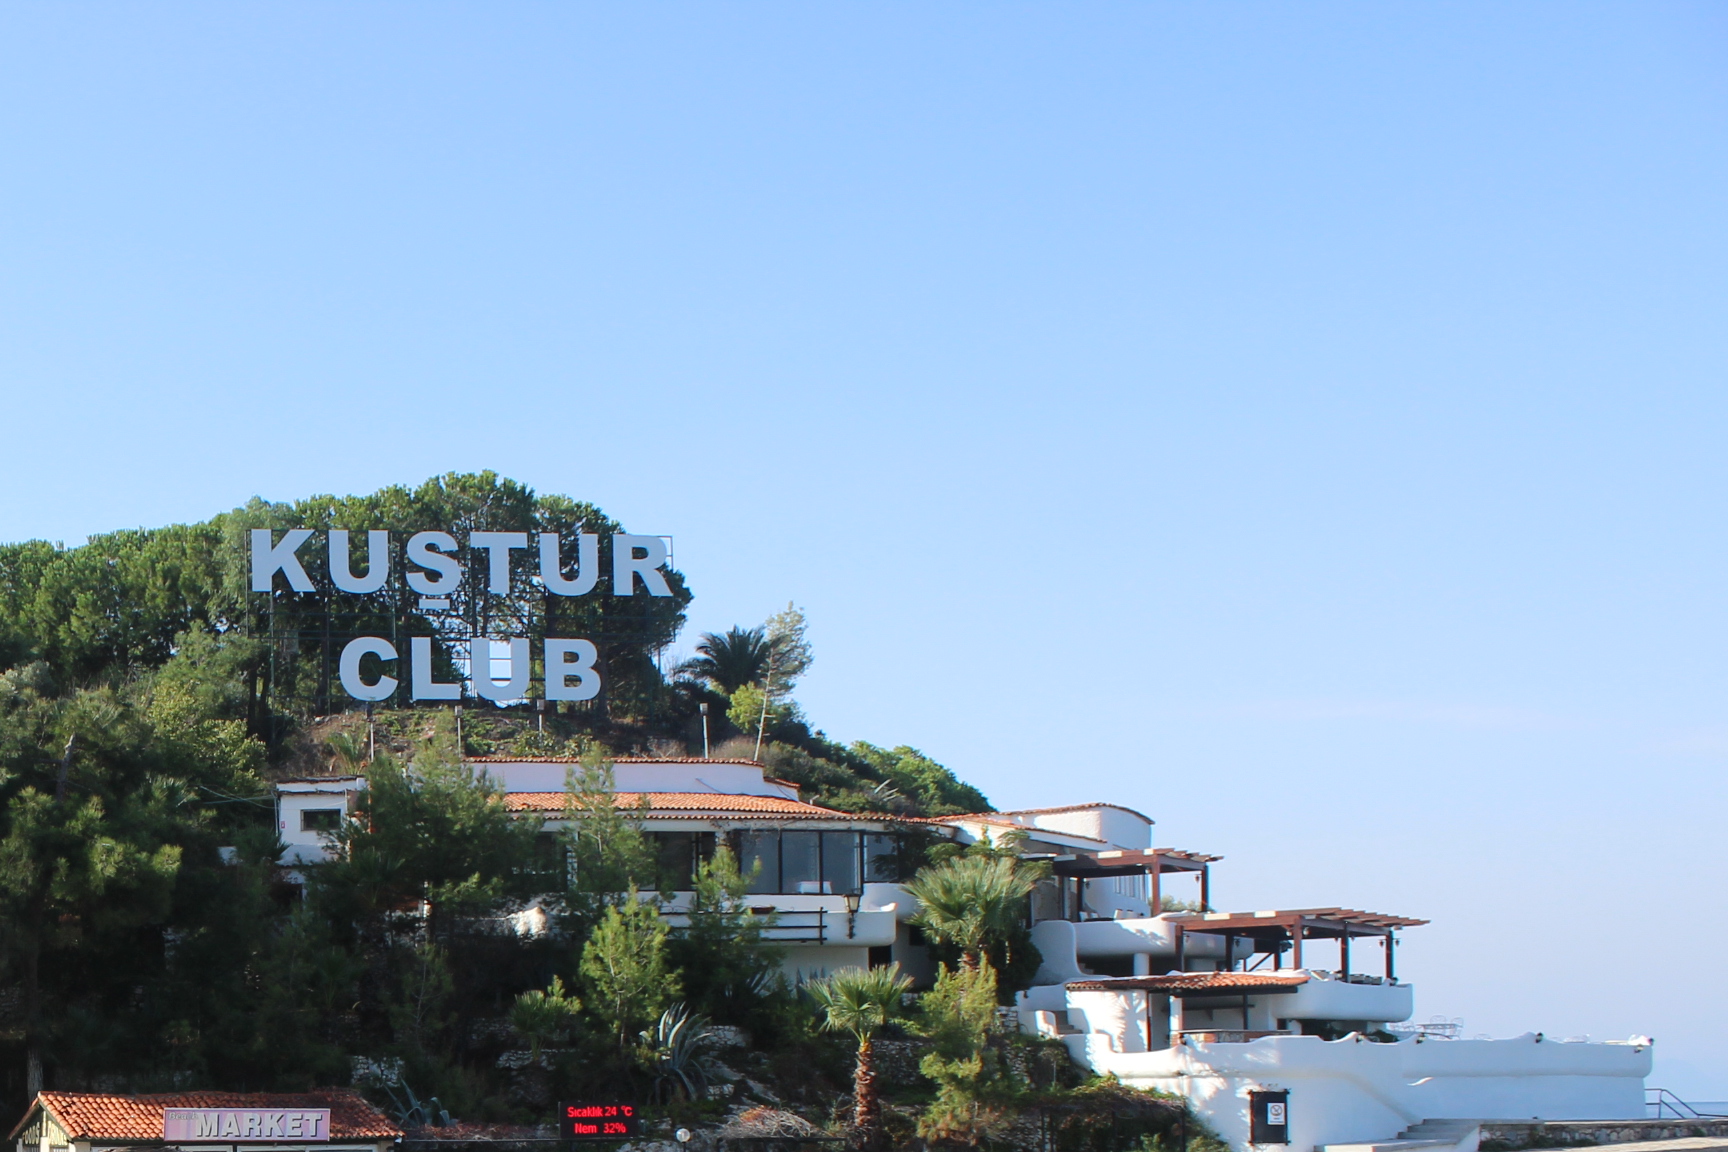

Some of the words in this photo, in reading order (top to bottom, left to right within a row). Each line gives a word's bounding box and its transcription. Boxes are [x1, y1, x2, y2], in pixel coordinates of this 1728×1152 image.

[339, 636, 601, 702] CLUB
[168, 1111, 199, 1120] Beach
[567, 1106, 603, 1118] Sıcaklık
[604, 1106, 617, 1116] 24
[620, 1105, 633, 1117] °C
[196, 1112, 323, 1138] MARKET
[574, 1122, 597, 1134] Nem
[603, 1122, 627, 1134] 32%
